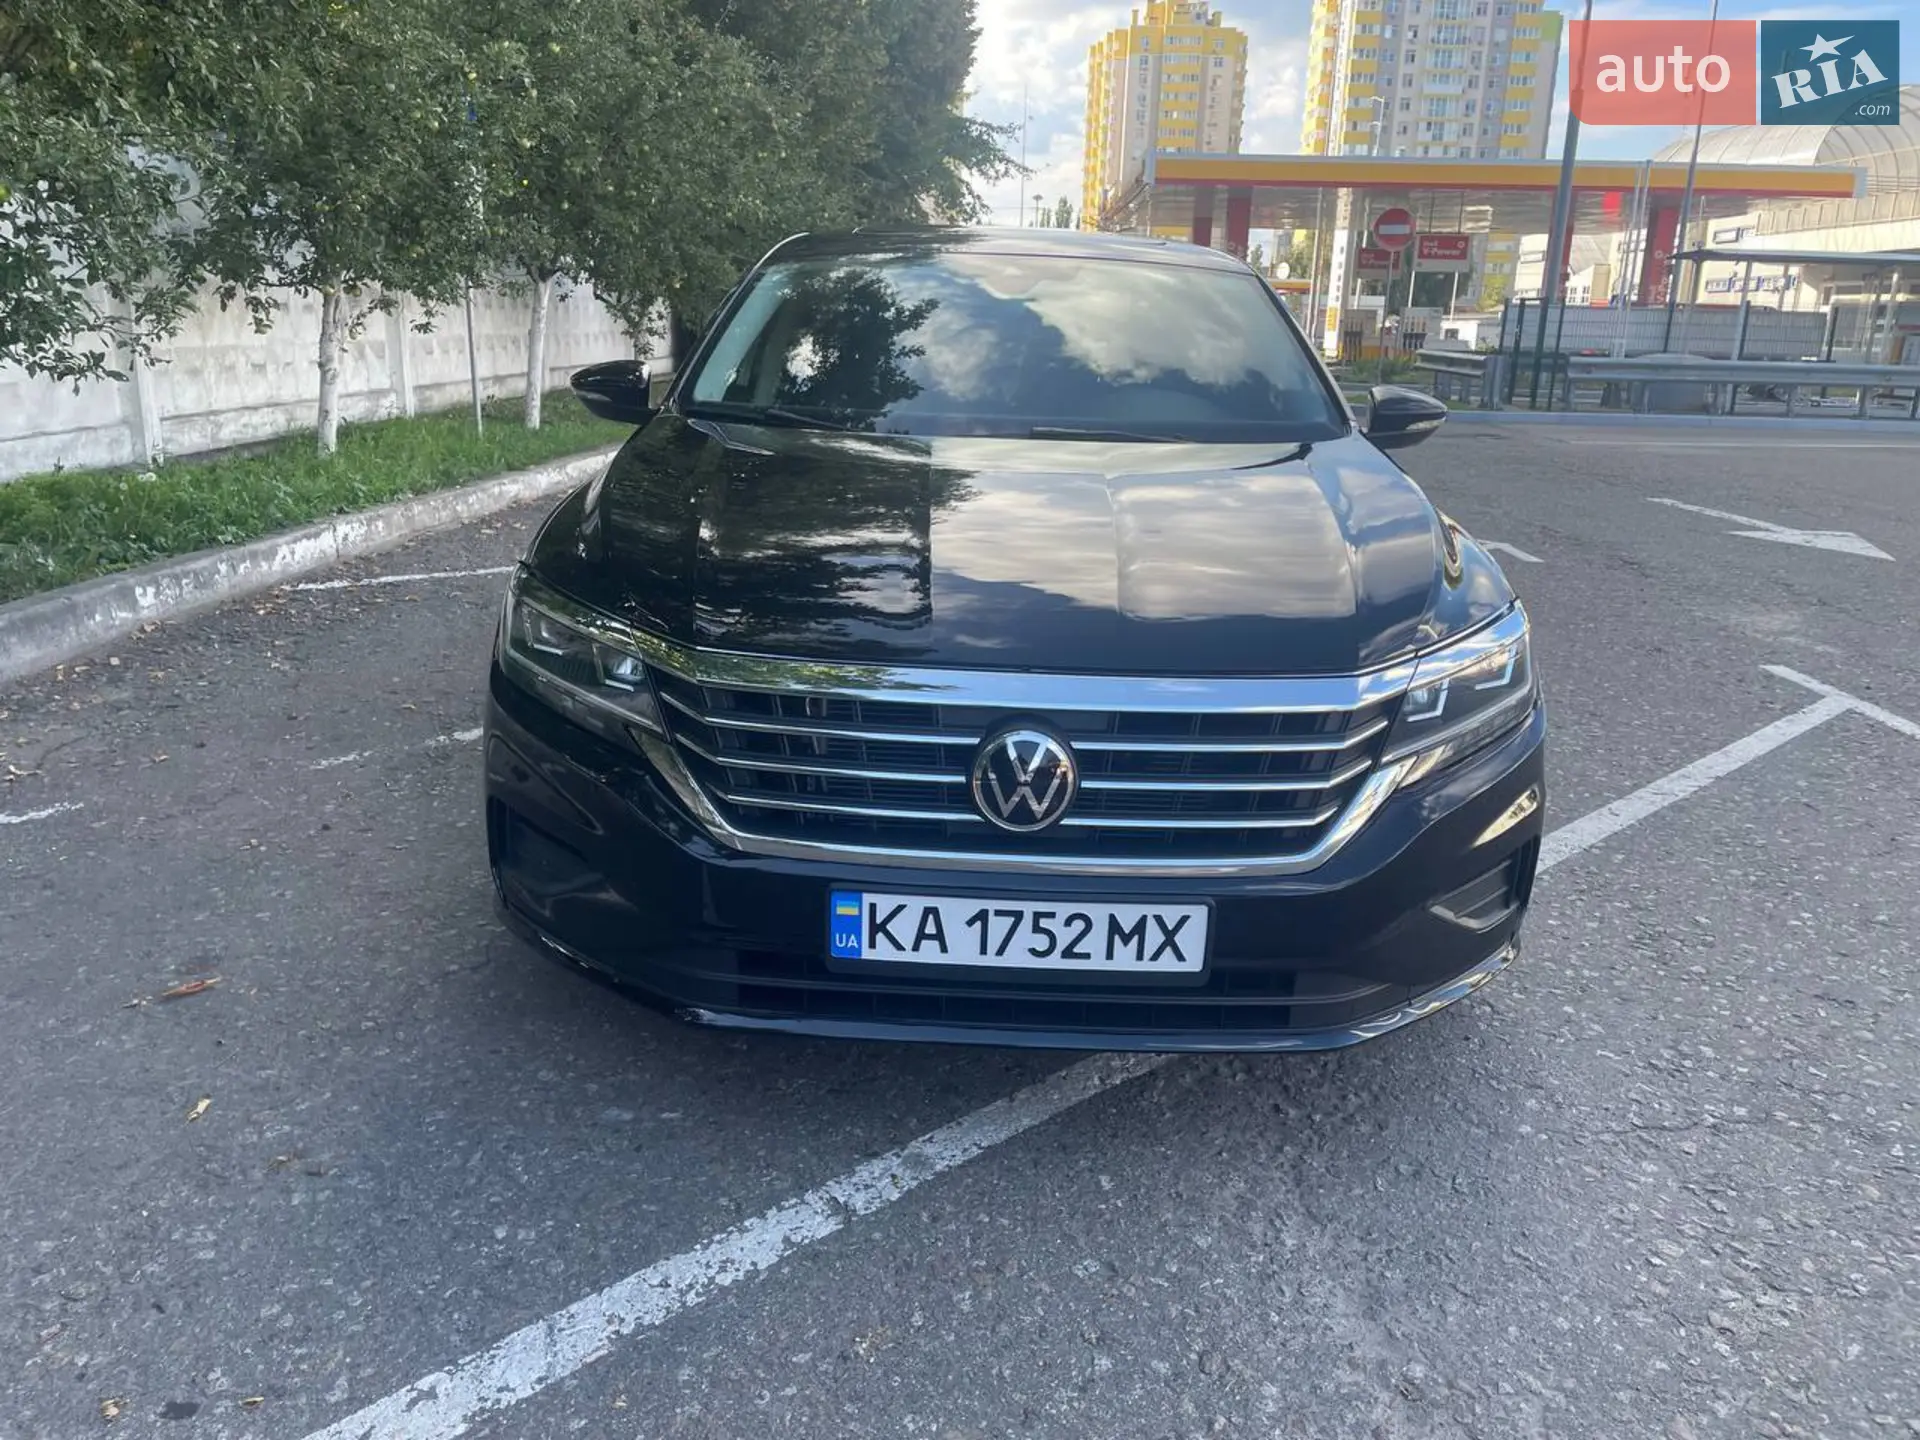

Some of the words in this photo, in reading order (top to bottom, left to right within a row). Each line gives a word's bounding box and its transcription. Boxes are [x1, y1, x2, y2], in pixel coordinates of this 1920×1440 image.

[836, 934, 859, 949] UA
[867, 902, 948, 954] KA
[965, 908, 1093, 960] 1752
[1105, 912, 1192, 963] MX
